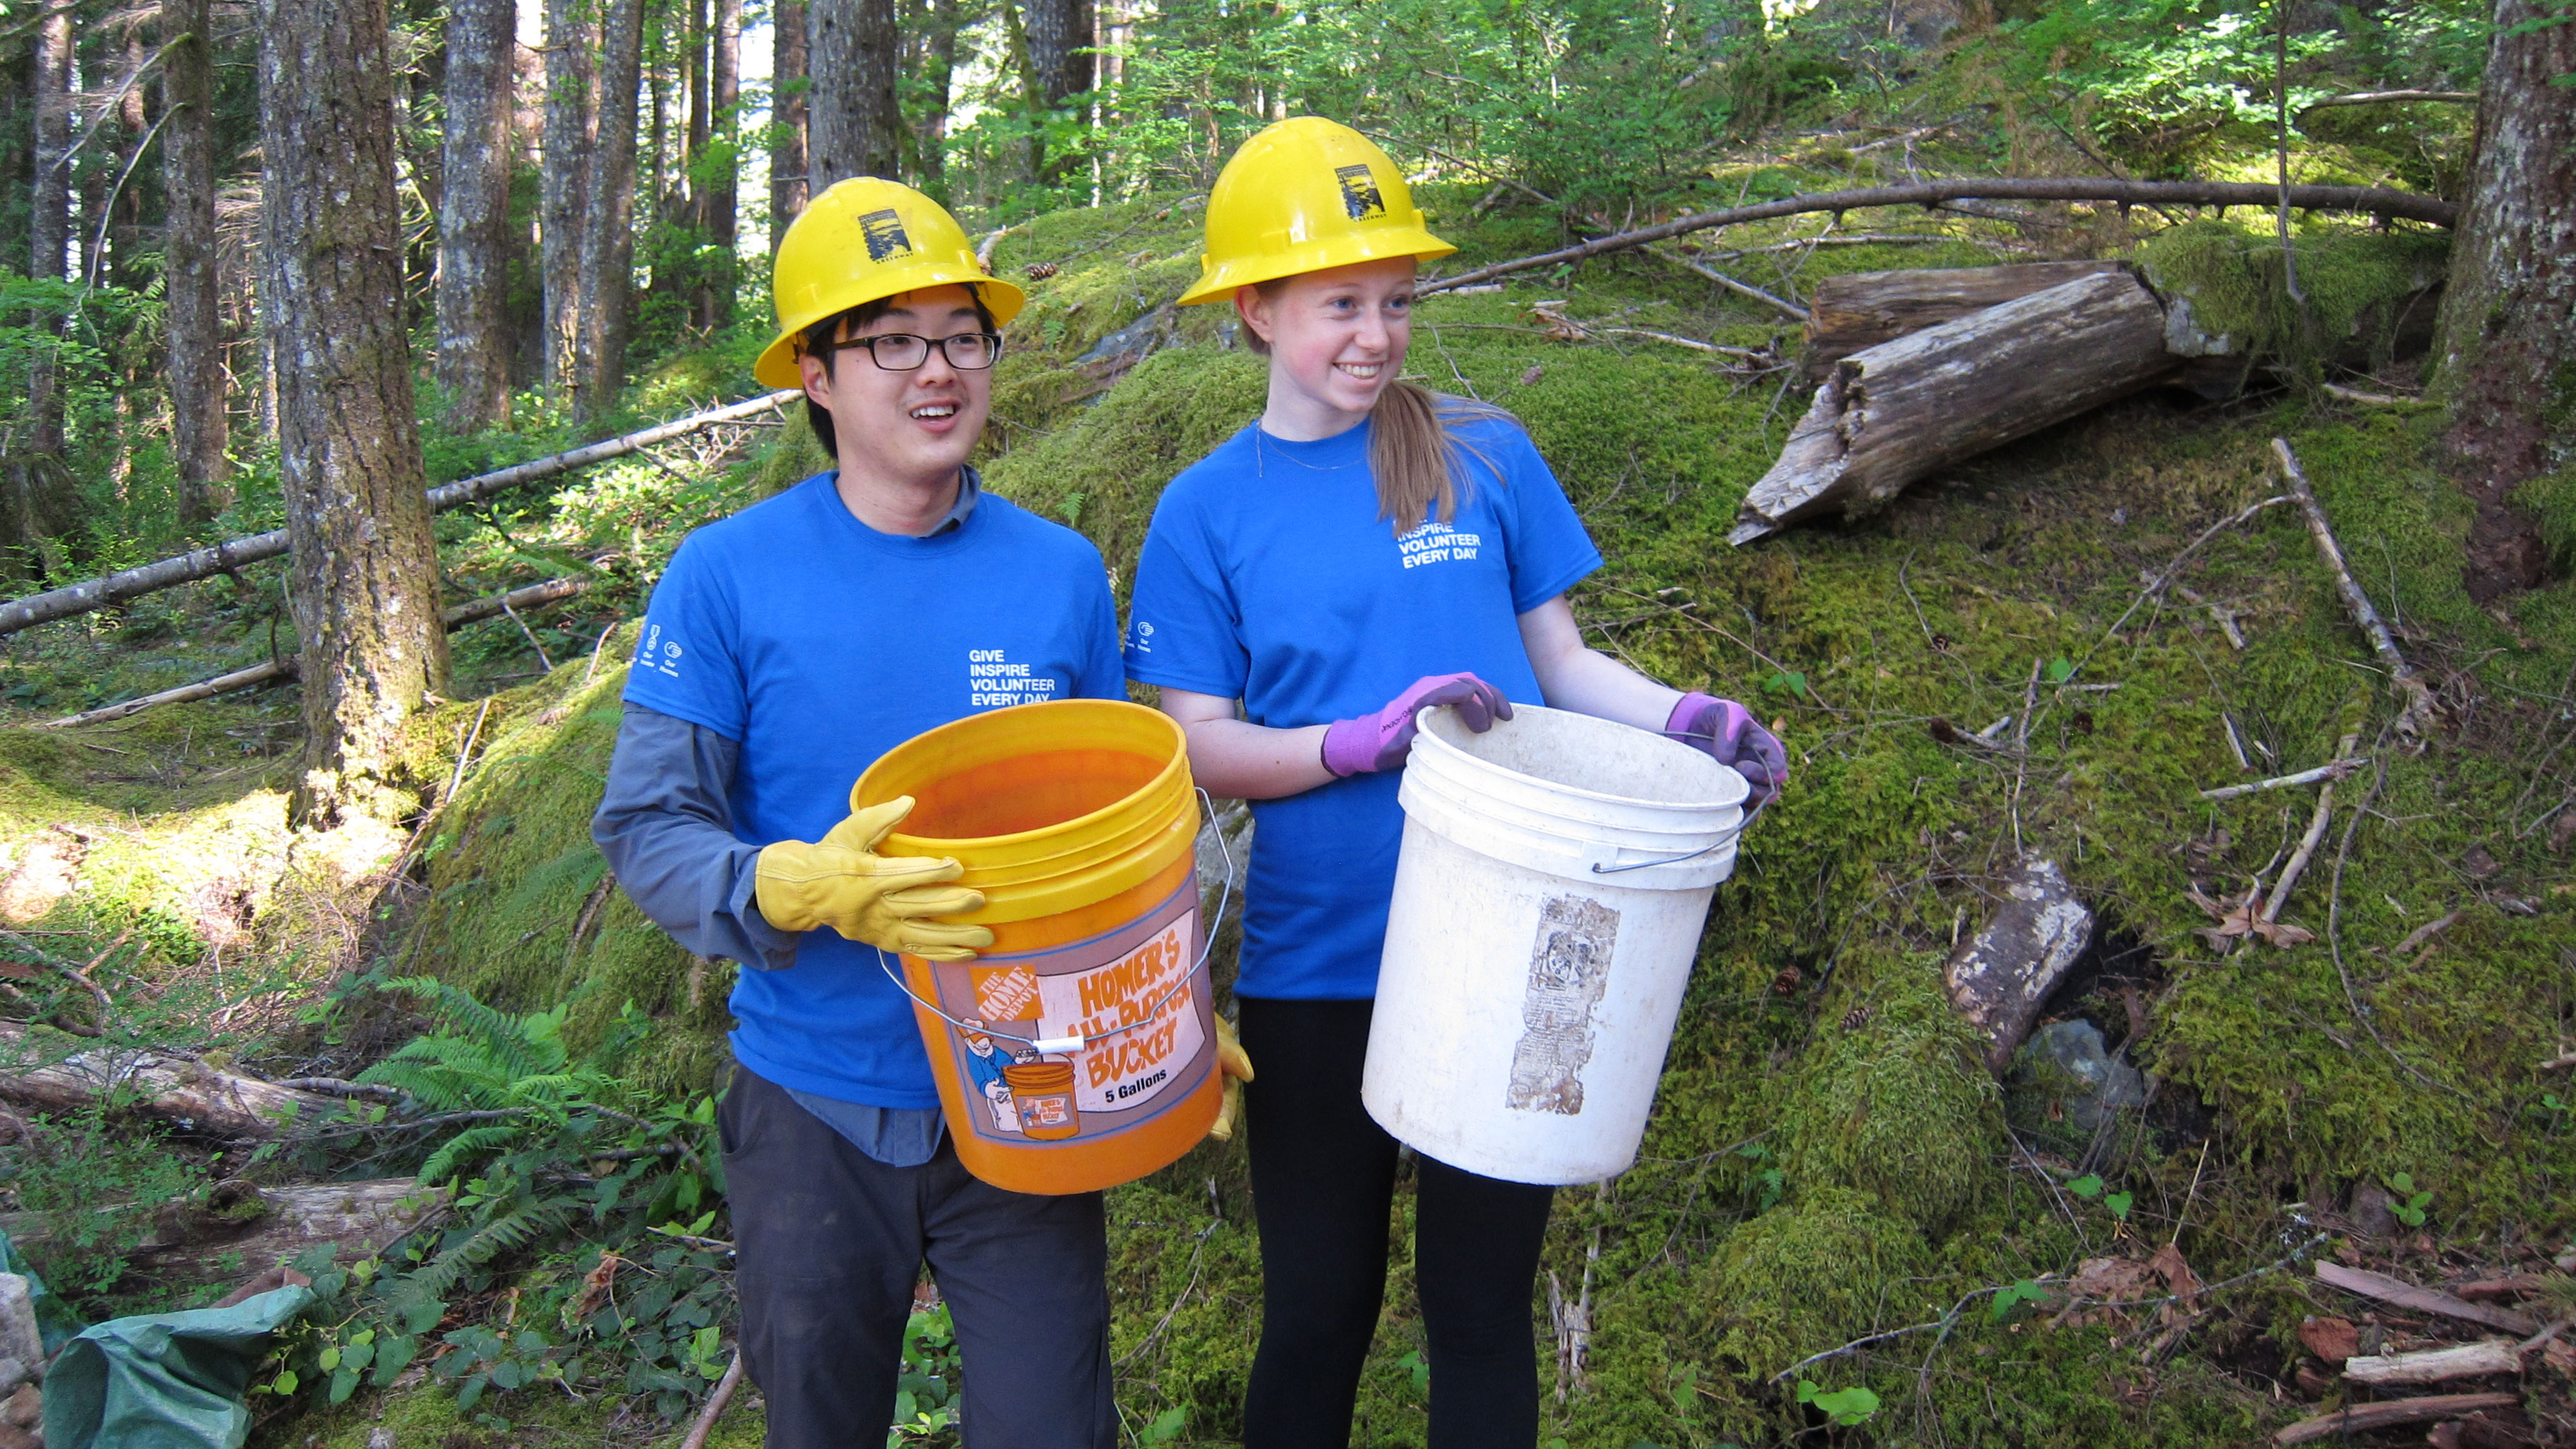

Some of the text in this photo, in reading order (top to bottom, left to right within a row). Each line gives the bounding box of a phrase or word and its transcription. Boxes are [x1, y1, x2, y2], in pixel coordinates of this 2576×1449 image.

[1398, 533, 1481, 555] VOLUNTEER
[1402, 547, 1477, 569] EVERY DAY
[969, 650, 1005, 662] GIVE
[970, 664, 1031, 676] INSPIRE
[970, 679, 1056, 691] VOLUNTEER
[972, 693, 1050, 706] EVERY DAY
[979, 972, 1005, 995] THE
[1078, 929, 1181, 1018] HOMER'S
[978, 966, 1035, 1021] HOME
[1003, 984, 1039, 1021] DEPOT
[1086, 1017, 1178, 1090] BUCKET
[1105, 1068, 1167, 1103] 5 Gallons
